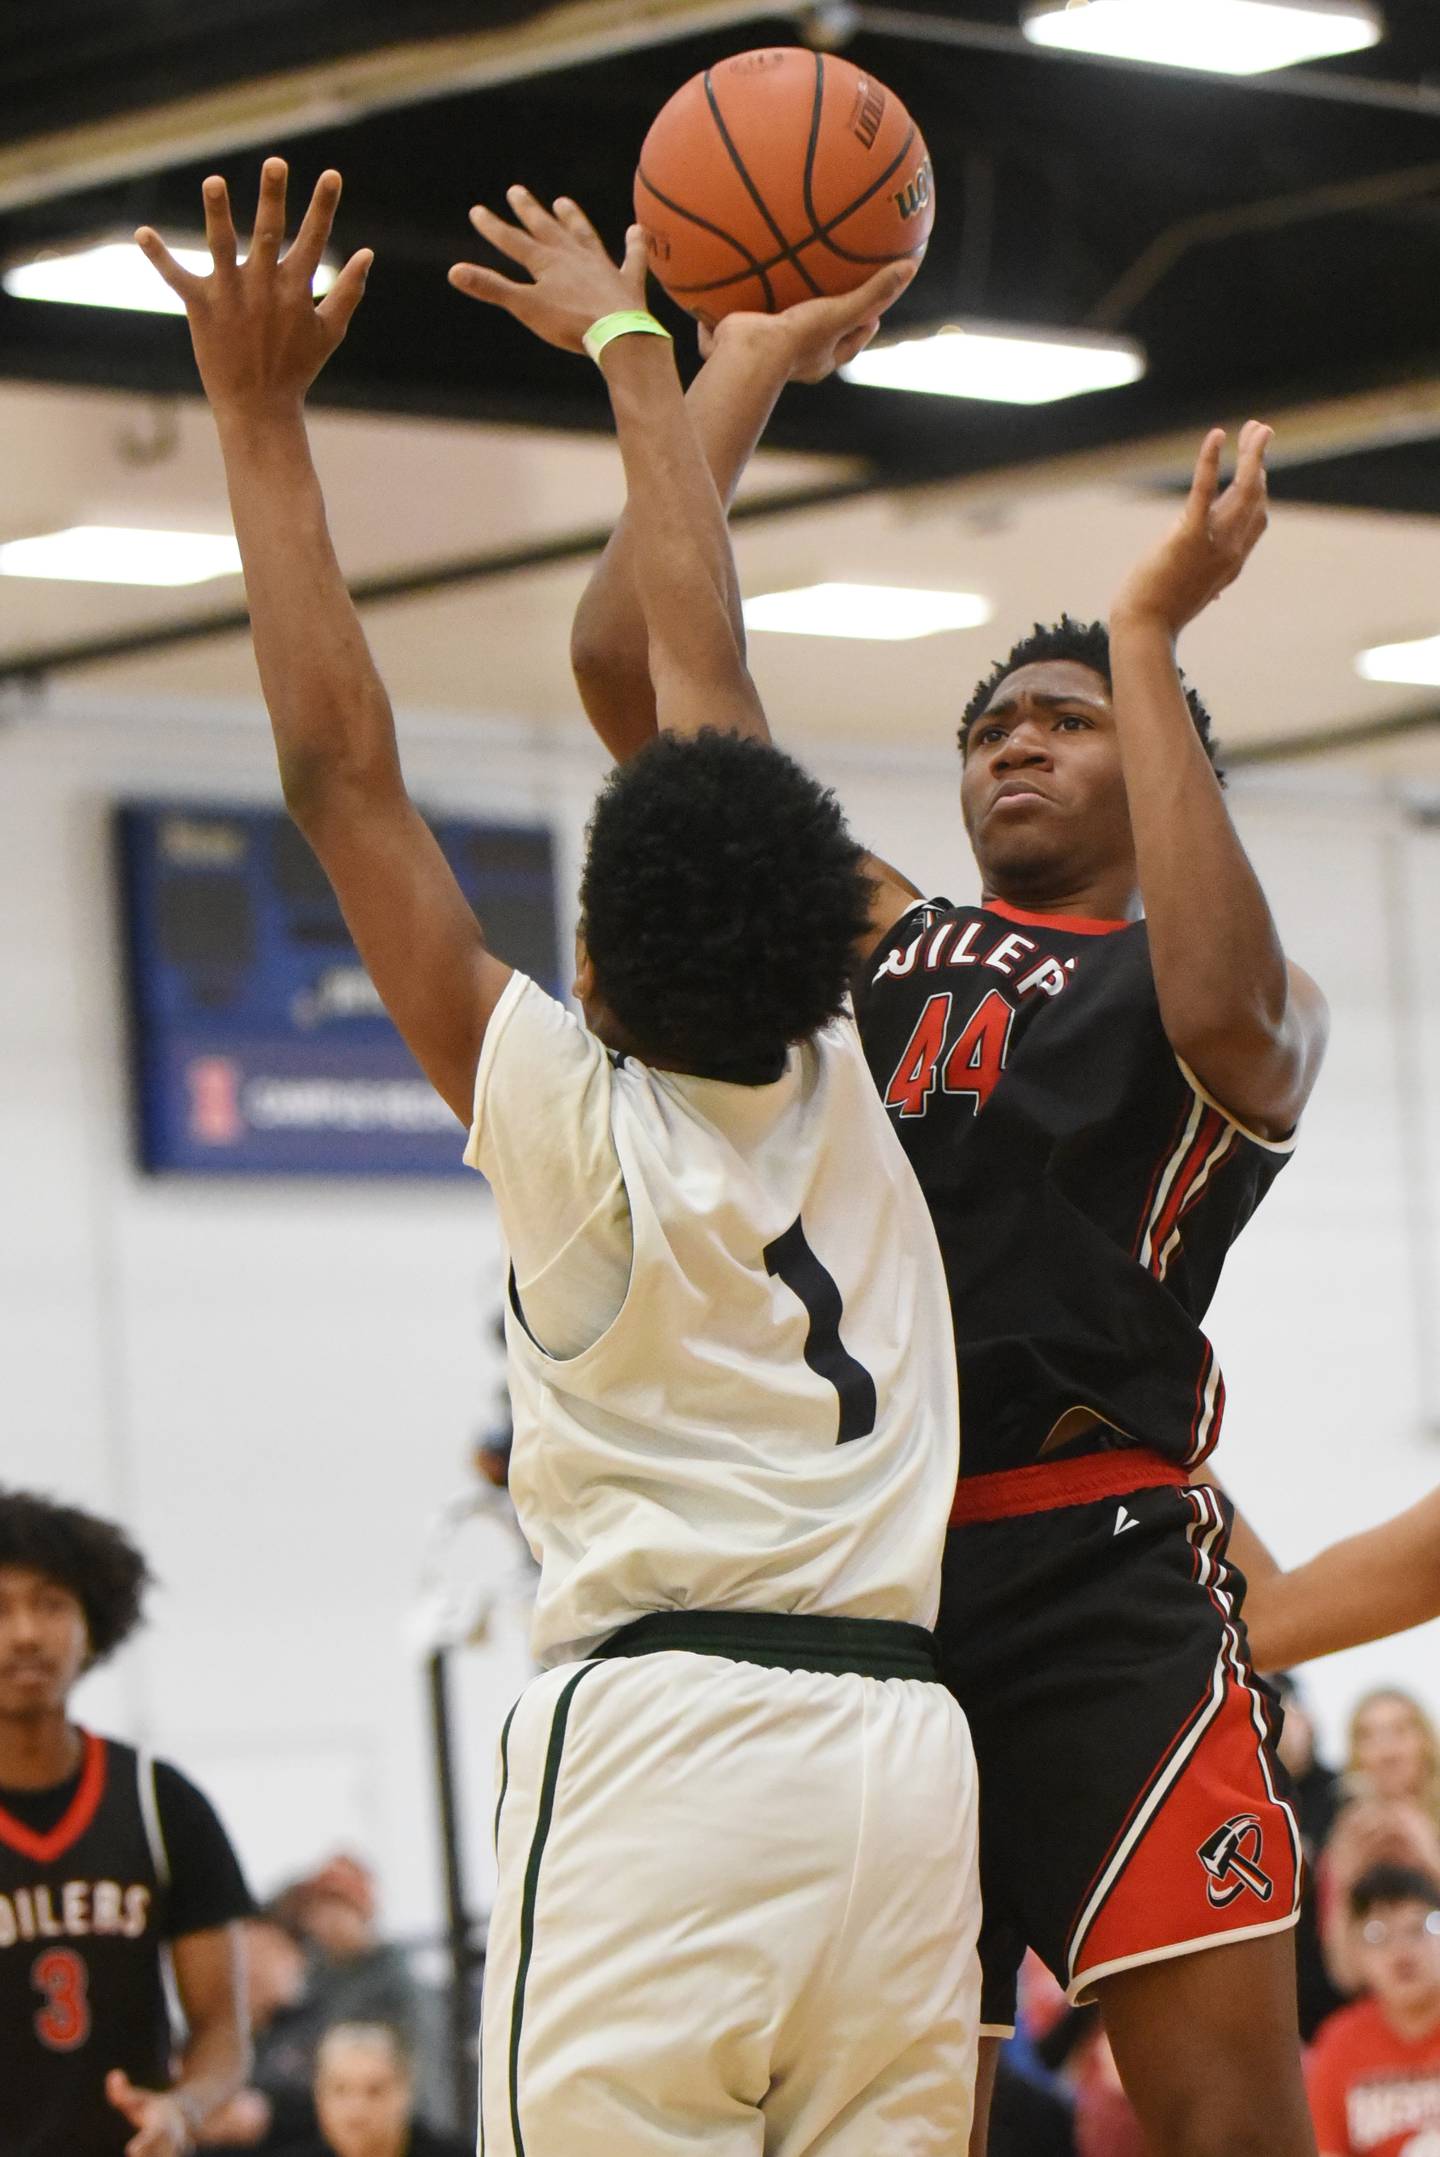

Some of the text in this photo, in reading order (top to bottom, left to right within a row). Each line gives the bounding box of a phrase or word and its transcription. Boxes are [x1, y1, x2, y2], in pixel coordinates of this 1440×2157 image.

[884, 988, 1016, 1119] 44
[762, 1211, 877, 1446] 1
[31, 1946, 91, 2053] 3
